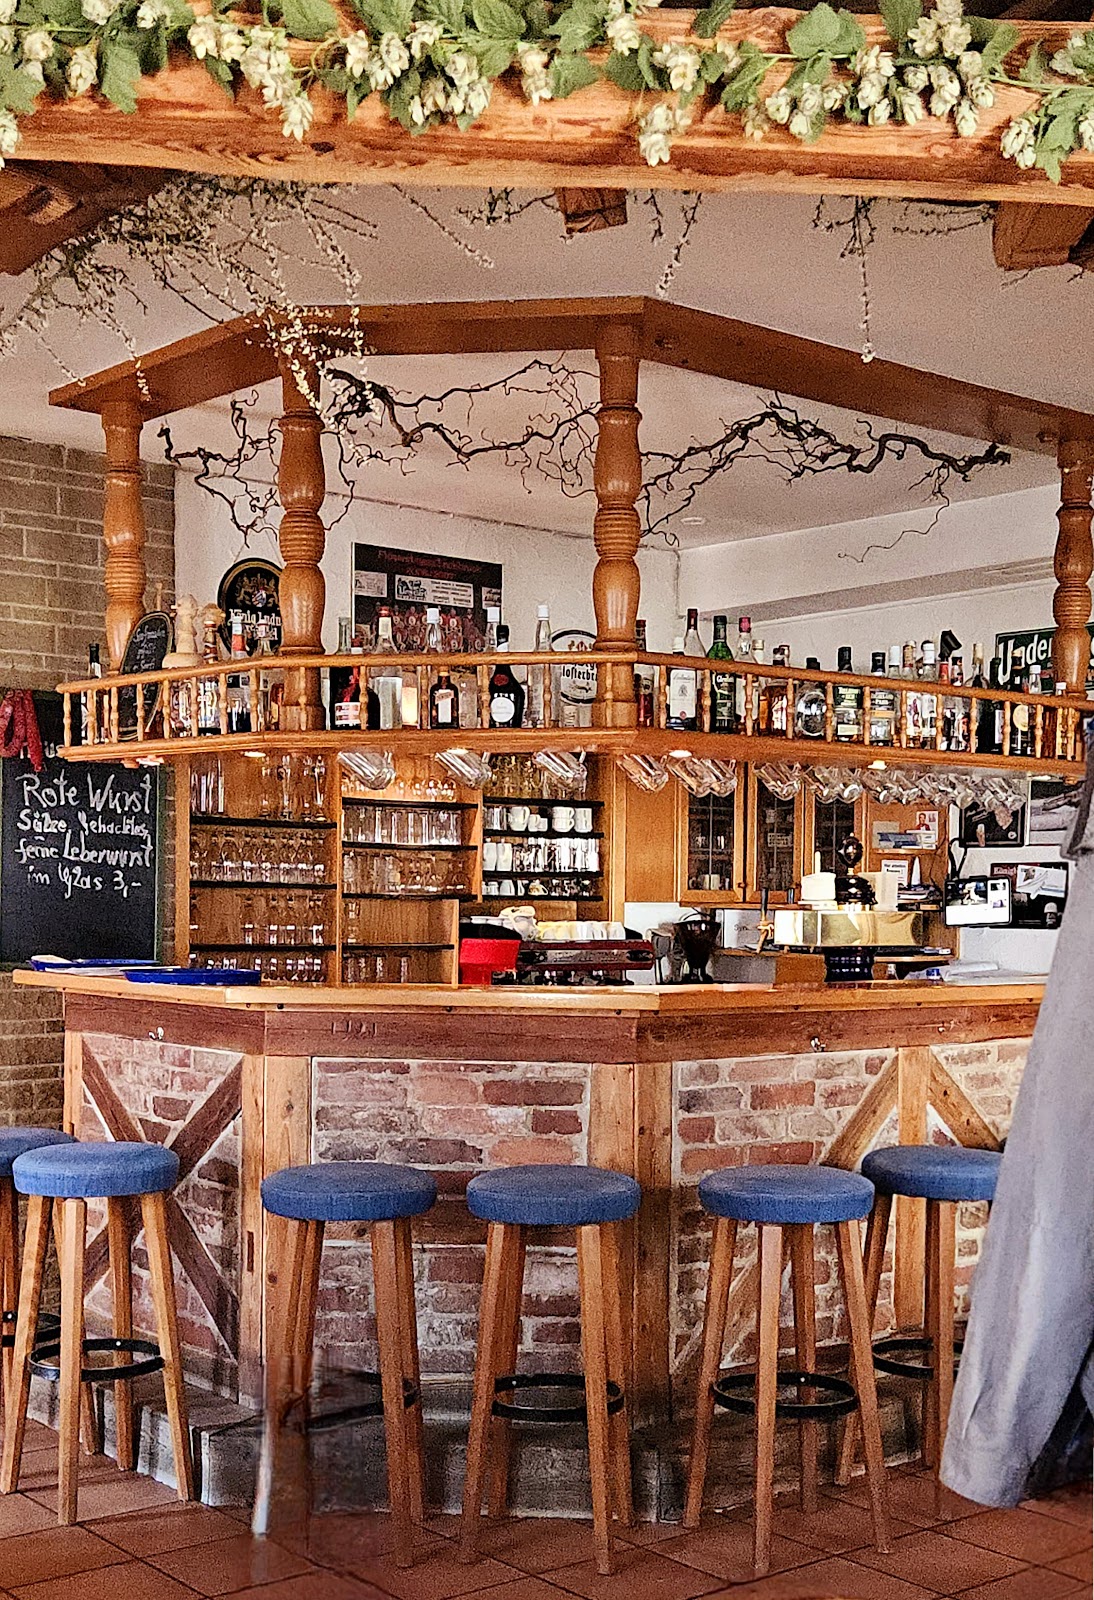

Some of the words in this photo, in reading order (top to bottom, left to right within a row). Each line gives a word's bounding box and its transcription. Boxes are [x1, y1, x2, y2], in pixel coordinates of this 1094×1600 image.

[15, 769, 80, 808] Rote
[87, 773, 152, 814] Wurst
[15, 836, 60, 863] feine
[63, 829, 153, 868] Leberwurst
[27, 865, 50, 884] im
[58, 863, 103, 898] Glas
